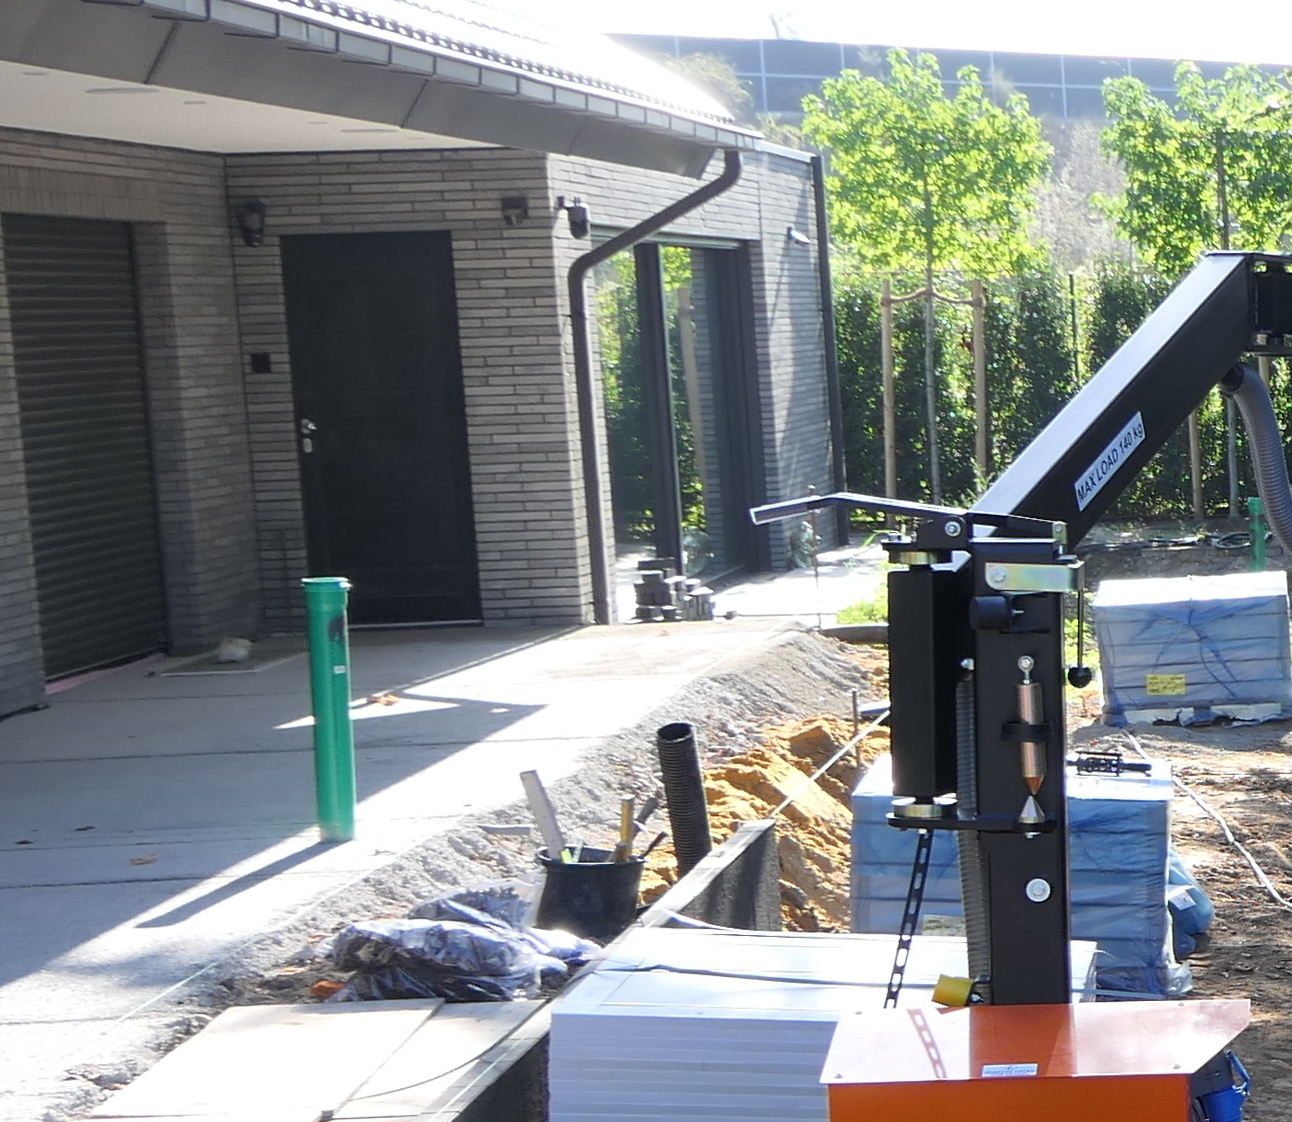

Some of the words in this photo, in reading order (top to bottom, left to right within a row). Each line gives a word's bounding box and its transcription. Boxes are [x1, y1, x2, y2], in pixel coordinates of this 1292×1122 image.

[1077, 472, 1097, 500] MAX
[1096, 448, 1119, 481] LOAD
[1119, 432, 1133, 454] 140
[1132, 423, 1144, 439] kg
